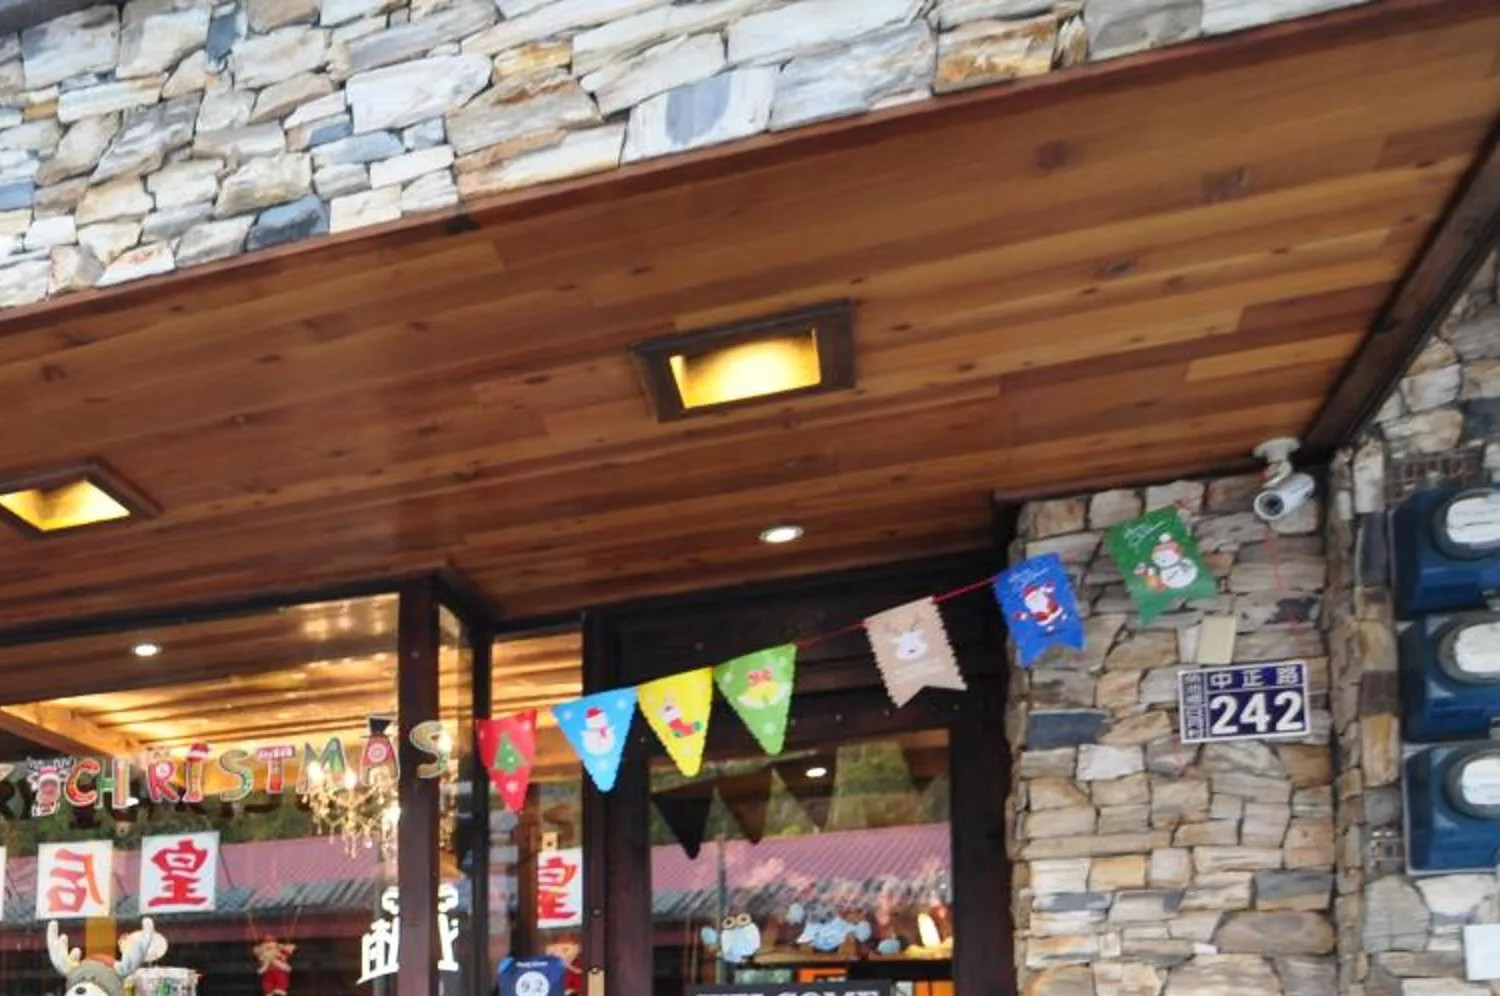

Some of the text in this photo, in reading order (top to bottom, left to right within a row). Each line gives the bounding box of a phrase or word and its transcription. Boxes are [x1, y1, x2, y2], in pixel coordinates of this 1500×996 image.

[1209, 665, 1299, 689] 中正路
[1209, 690, 1304, 735] 242
[64, 714, 454, 809] CHRISTMAS
